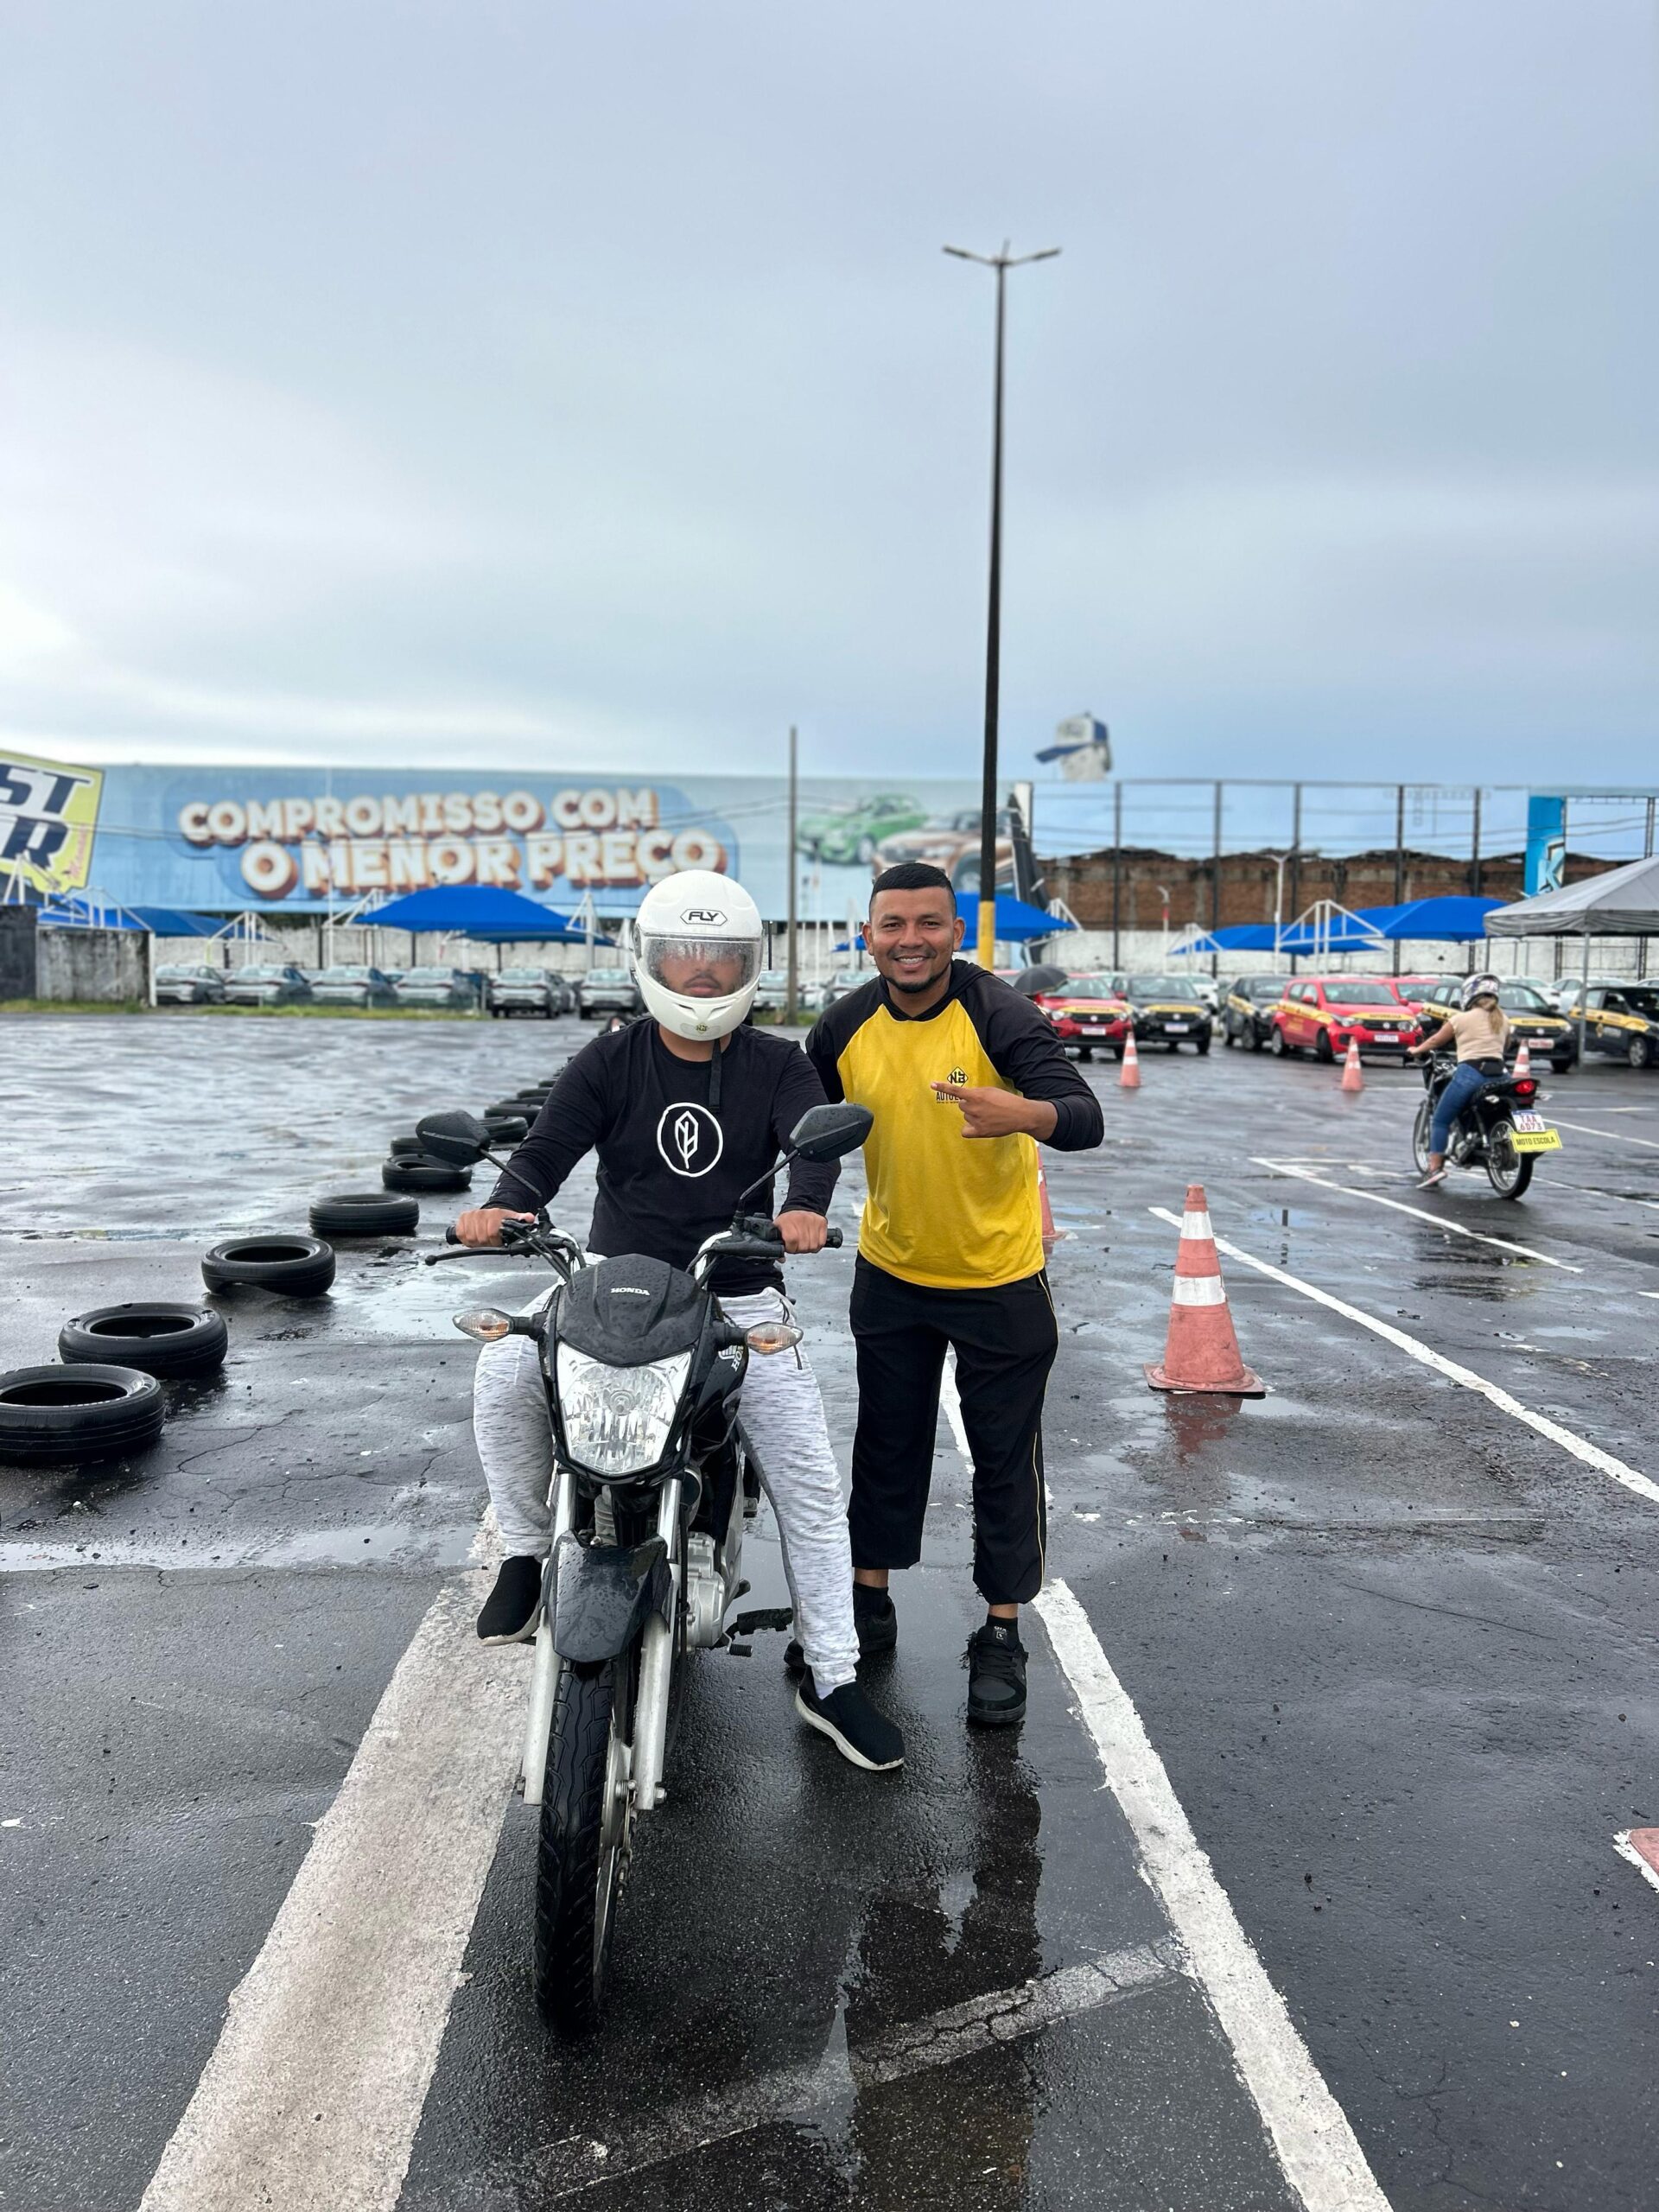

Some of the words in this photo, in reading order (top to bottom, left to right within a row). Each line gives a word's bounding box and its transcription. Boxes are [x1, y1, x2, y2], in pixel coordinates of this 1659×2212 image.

[179, 791, 544, 845] COMPROMISSO
[551, 788, 658, 830] COM
[241, 842, 297, 899] O
[302, 833, 522, 895] MENOR
[688, 911, 720, 922] FLY
